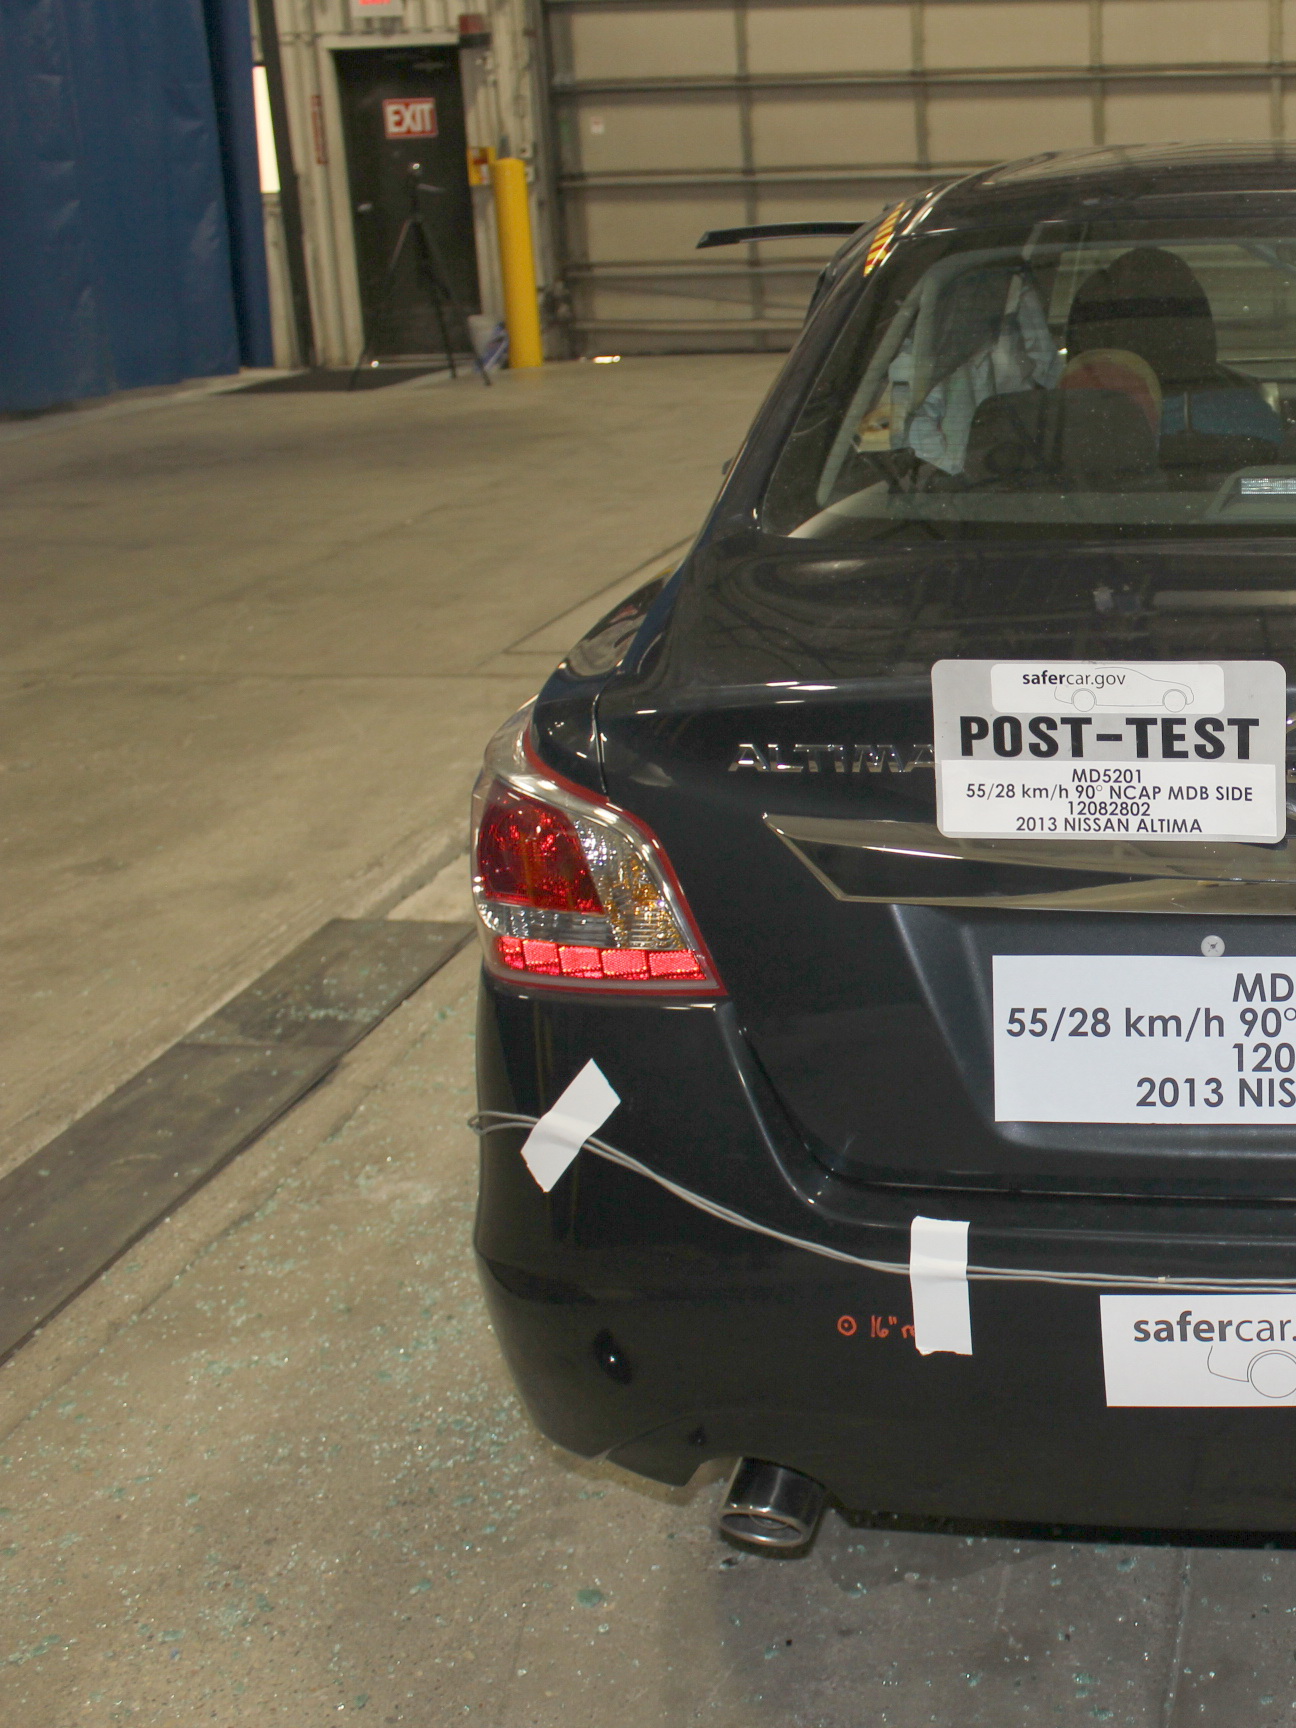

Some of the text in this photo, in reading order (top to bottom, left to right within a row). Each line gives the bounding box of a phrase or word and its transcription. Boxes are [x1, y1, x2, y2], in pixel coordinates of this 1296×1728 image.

[386, 103, 433, 134] EXIT
[1022, 669, 1126, 689] safercar.gov
[960, 715, 1260, 760] POST-TEST
[728, 743, 935, 772] ALTIMA
[1071, 768, 1142, 784] MD5201
[965, 783, 1016, 800] 55/28
[1021, 784, 1069, 801] km/h
[1109, 786, 1162, 801] NCAP
[1167, 786, 1210, 801] MDB
[1215, 787, 1254, 802] SIDE
[1067, 801, 1151, 816] 12082802
[1016, 816, 1203, 833] 2013 NISSAN ALTIMA
[1006, 1006, 1111, 1042] 55/28
[1124, 1007, 1224, 1042] km/h
[1136, 1077, 1224, 1107] 2013
